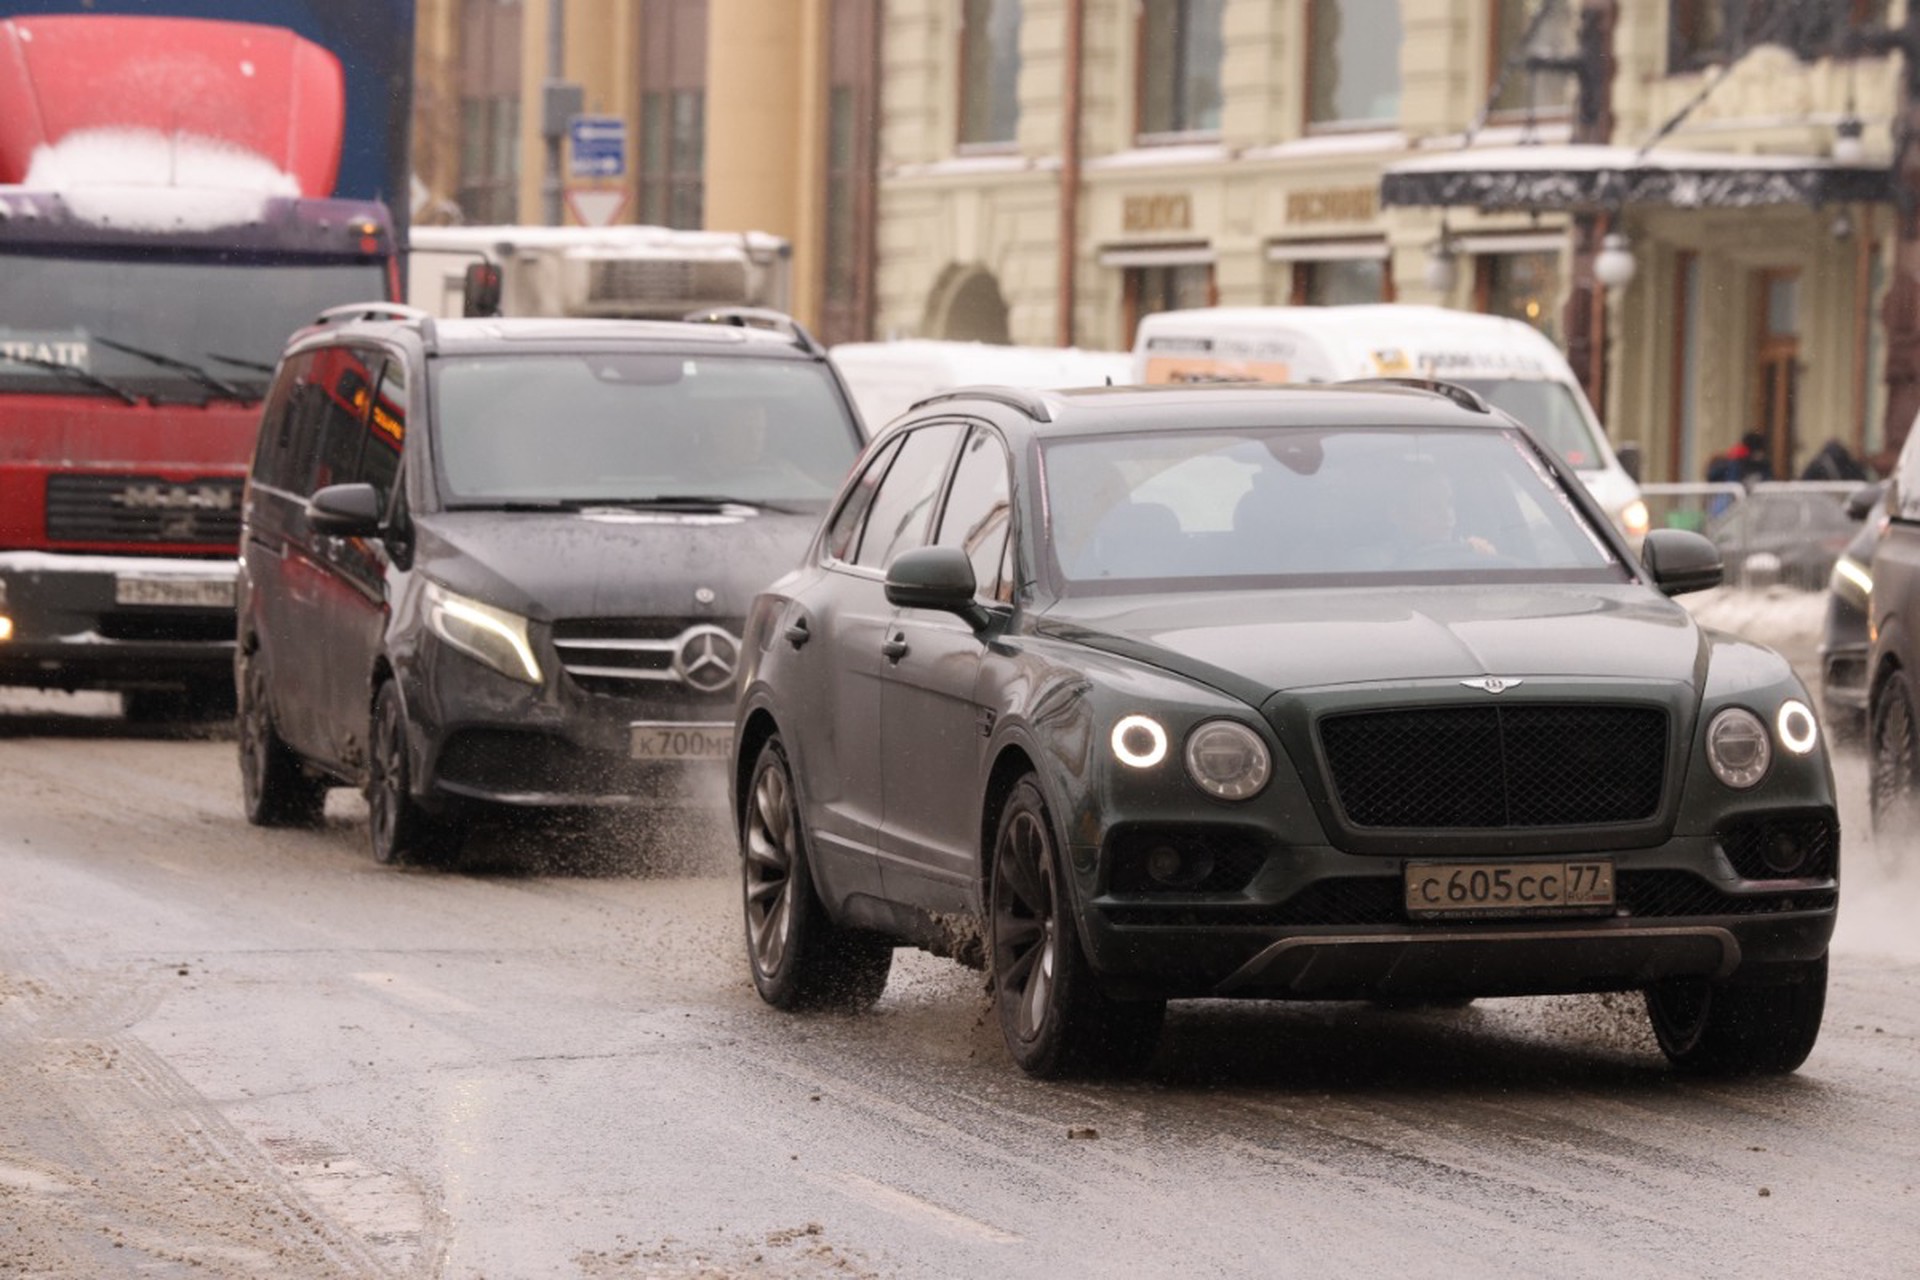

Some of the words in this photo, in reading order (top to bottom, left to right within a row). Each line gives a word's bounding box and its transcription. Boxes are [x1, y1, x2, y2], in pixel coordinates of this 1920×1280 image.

[124, 485, 233, 509] MAN
[1421, 868, 1559, 903] С605СС
[1568, 865, 1601, 893] 77
